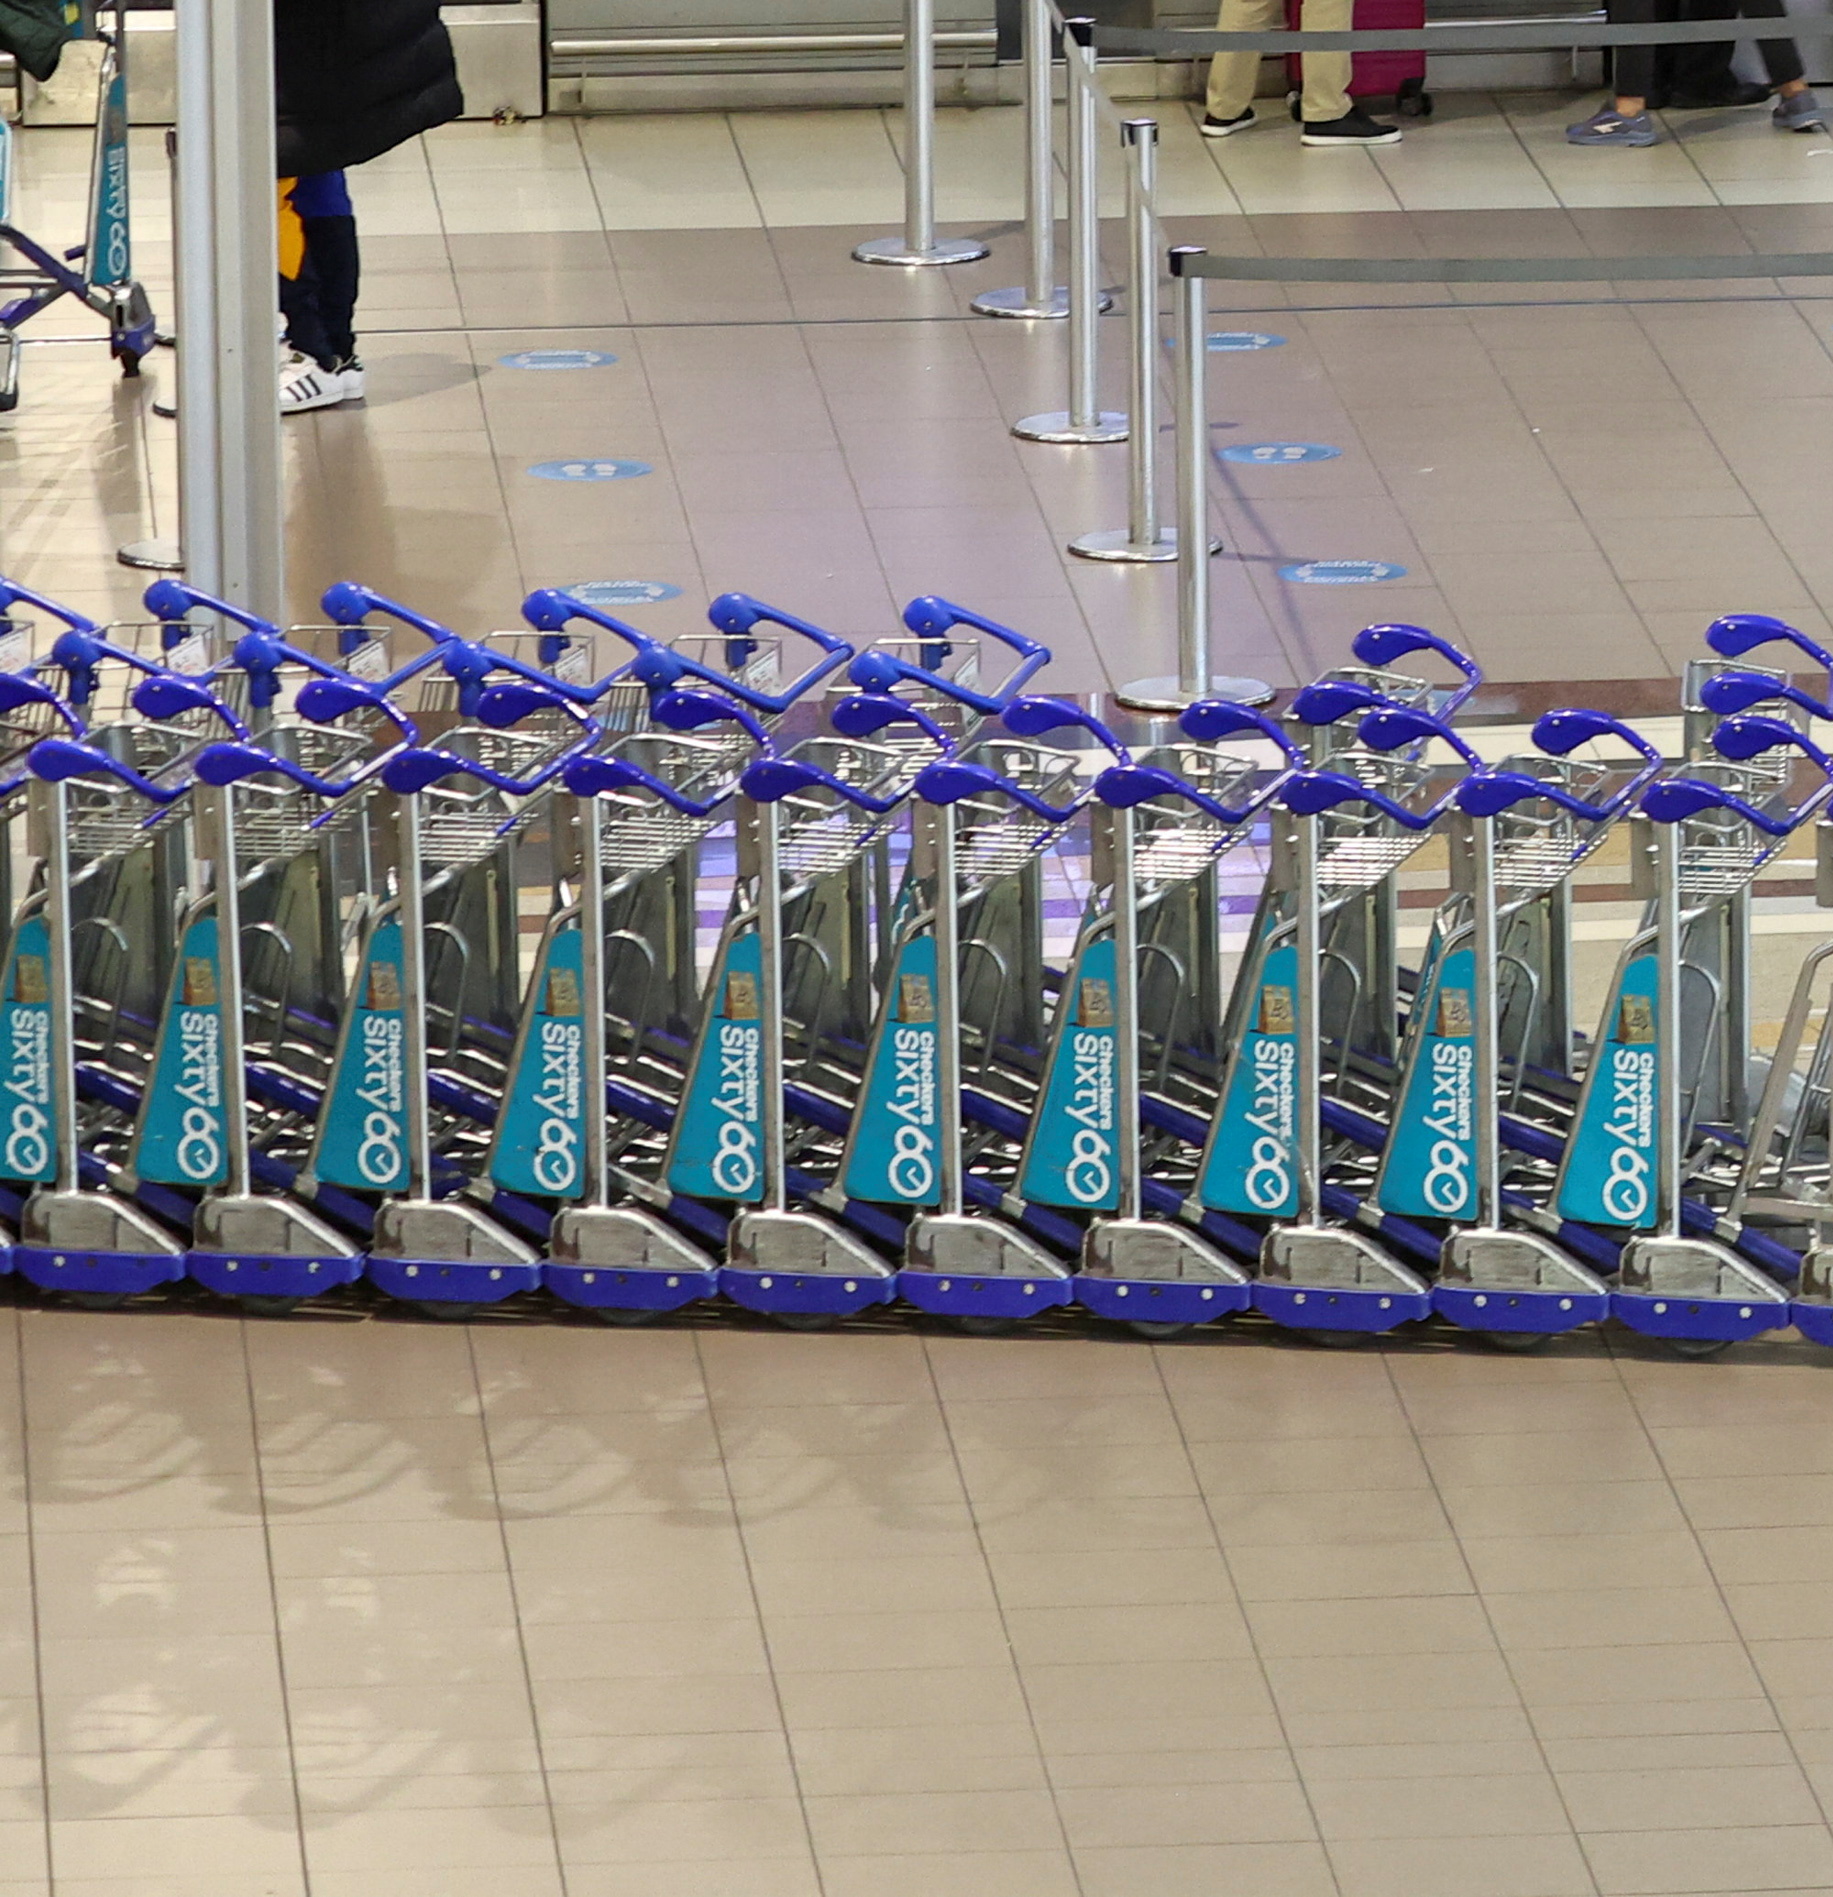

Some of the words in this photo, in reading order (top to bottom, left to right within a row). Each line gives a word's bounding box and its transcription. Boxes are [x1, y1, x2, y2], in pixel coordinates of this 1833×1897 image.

[5, 1009, 50, 1174] Sixty60
[175, 1012, 220, 1179] Sixty60
[202, 1014, 219, 1106] Checkers
[357, 1016, 403, 1183] Sixty60
[385, 1019, 402, 1111] Checkers
[533, 1022, 580, 1190] Sixty60
[564, 1026, 581, 1118] Checkers
[712, 1025, 761, 1193] Sixty60
[742, 1028, 759, 1121] Checkers
[887, 1029, 935, 1197] Sixty60
[918, 1032, 935, 1124] Checkers
[1065, 1033, 1113, 1202] Sixty60
[1095, 1036, 1113, 1129] Checkers
[1245, 1040, 1293, 1209] Sixty60
[1276, 1043, 1294, 1138] Checkers
[1423, 1043, 1471, 1212] Sixty60
[1454, 1046, 1472, 1140] Checkers
[1603, 1050, 1652, 1220] Sixty60
[1637, 1053, 1654, 1147] Checkers
